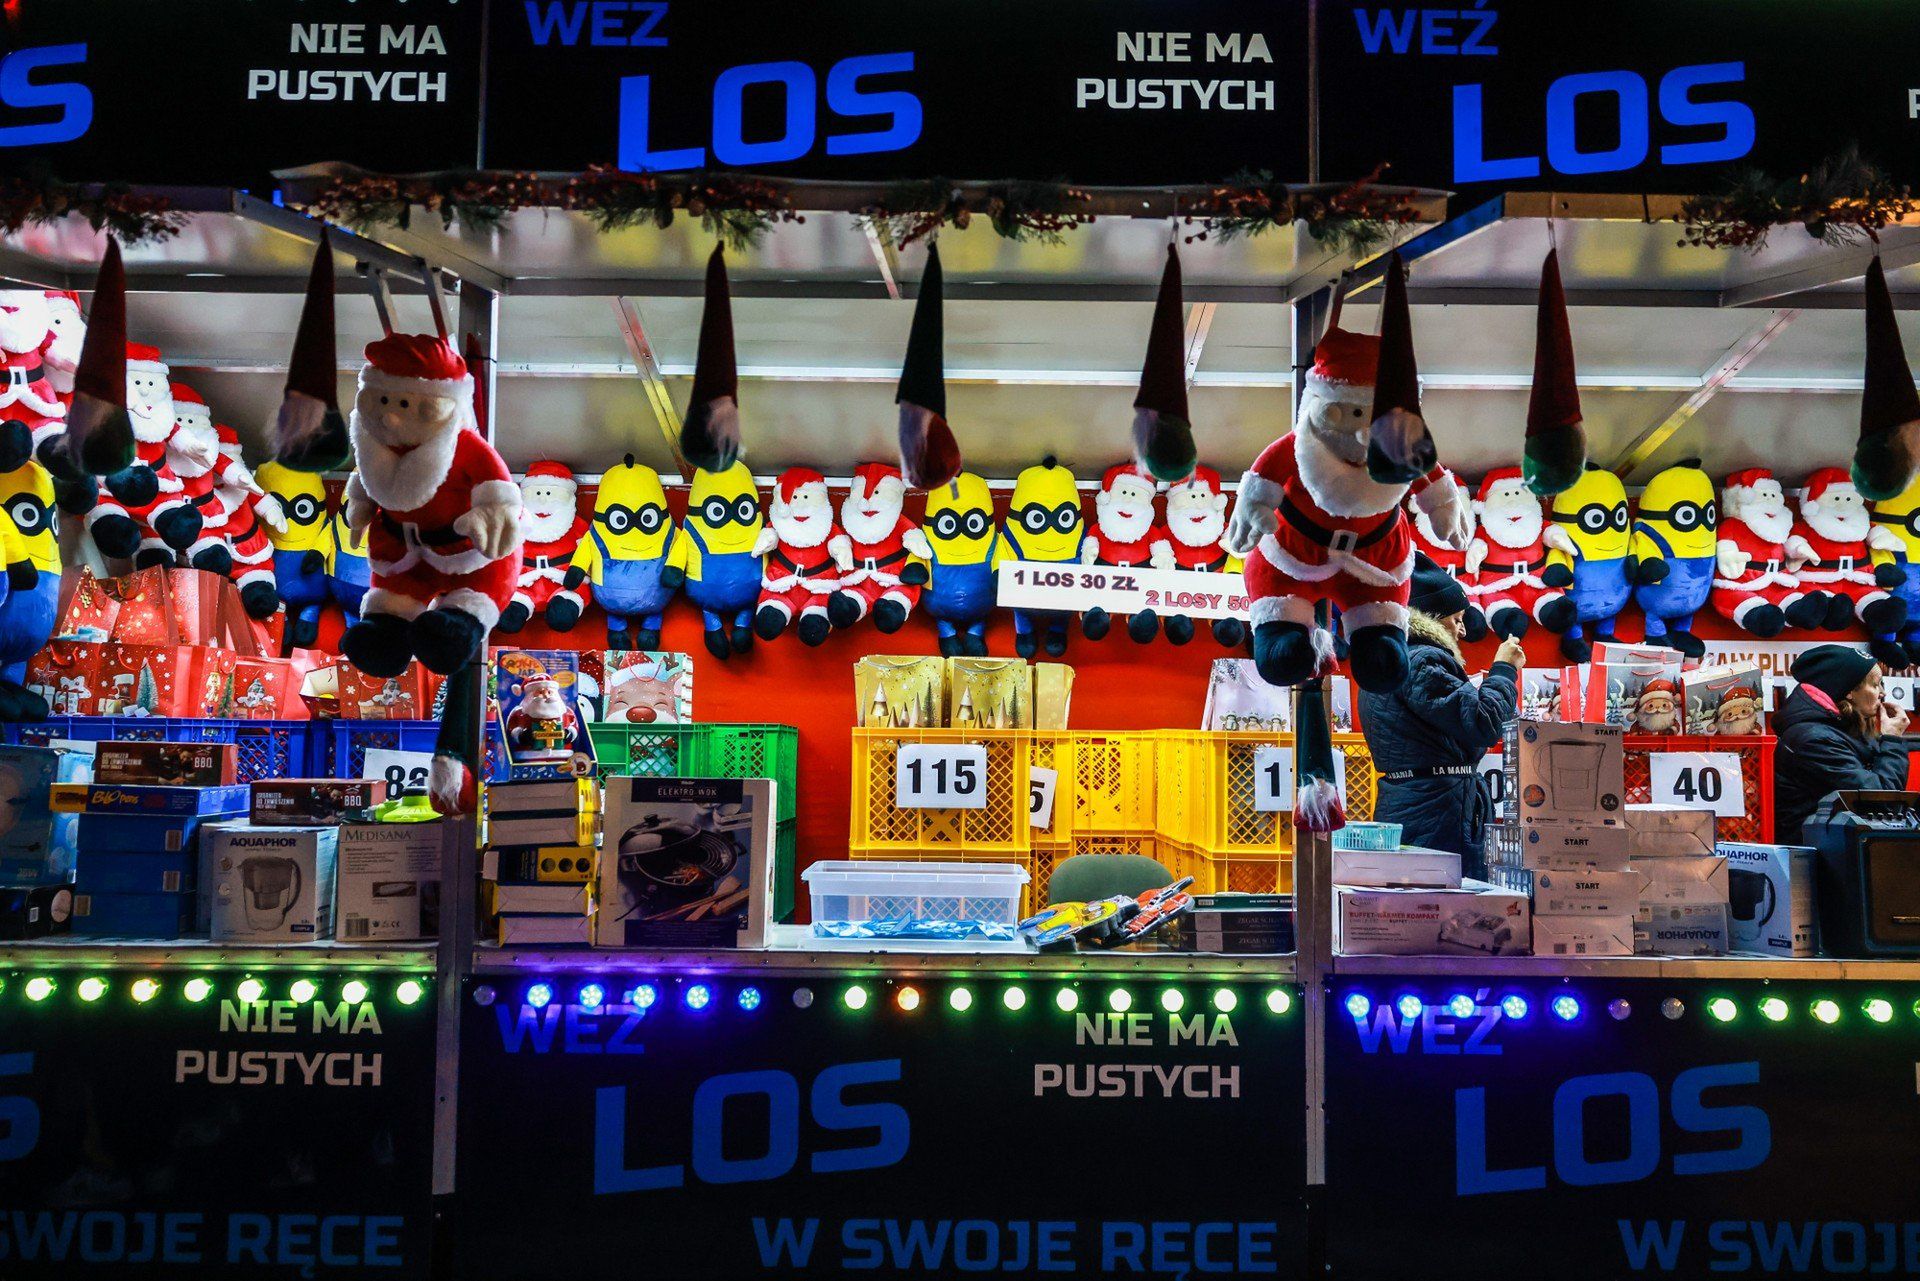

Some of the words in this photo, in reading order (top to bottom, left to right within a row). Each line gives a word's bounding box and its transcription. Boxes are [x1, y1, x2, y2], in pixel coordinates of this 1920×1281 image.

[290, 23, 366, 54] NIE
[379, 24, 447, 55] MA
[1117, 31, 1192, 62] NIE
[1206, 32, 1274, 63] MA
[247, 69, 447, 102] PUSTYCH
[1076, 78, 1275, 111] PUSTYCH
[618, 51, 923, 173] LOS
[1453, 61, 1756, 184] LOS
[1014, 569, 1024, 585] 1
[1033, 570, 1075, 588] LOS
[1081, 573, 1106, 589] 30
[1112, 575, 1139, 591] ZŁ
[1145, 590, 1160, 606] 2
[1165, 591, 1222, 610] LOSY
[1228, 595, 1250, 611] 50
[194, 757, 213, 768] BBQ
[906, 758, 978, 795] 115
[344, 795, 362, 807] BBQ
[657, 787, 694, 796] ELEKTRO
[698, 788, 717, 796] WOK
[1673, 766, 1722, 802] 40
[229, 837, 297, 847] AQUAPHOR
[345, 829, 412, 841] MEDISANA
[1564, 838, 1589, 846] START
[1575, 882, 1600, 890] START
[1656, 930, 1721, 940] AQUAPHOR
[219, 998, 298, 1033] NIE
[313, 1000, 383, 1034] MA
[1075, 1012, 1153, 1046] NIE
[1168, 1013, 1239, 1047] MA
[1353, 988, 1502, 1055] WEŹ
[176, 1050, 382, 1086] PUSTYCH
[1034, 1063, 1240, 1098] PUSTYCH
[594, 1058, 911, 1196] LOS
[1455, 1061, 1772, 1197] LOS
[0, 1212, 203, 1262] WOJE
[227, 1213, 404, 1278] RĘCE
[752, 1216, 820, 1268] W
[840, 1217, 1078, 1272] SWOJE
[1101, 1219, 1278, 1281] RĘCE
[1617, 1218, 1686, 1271] W
